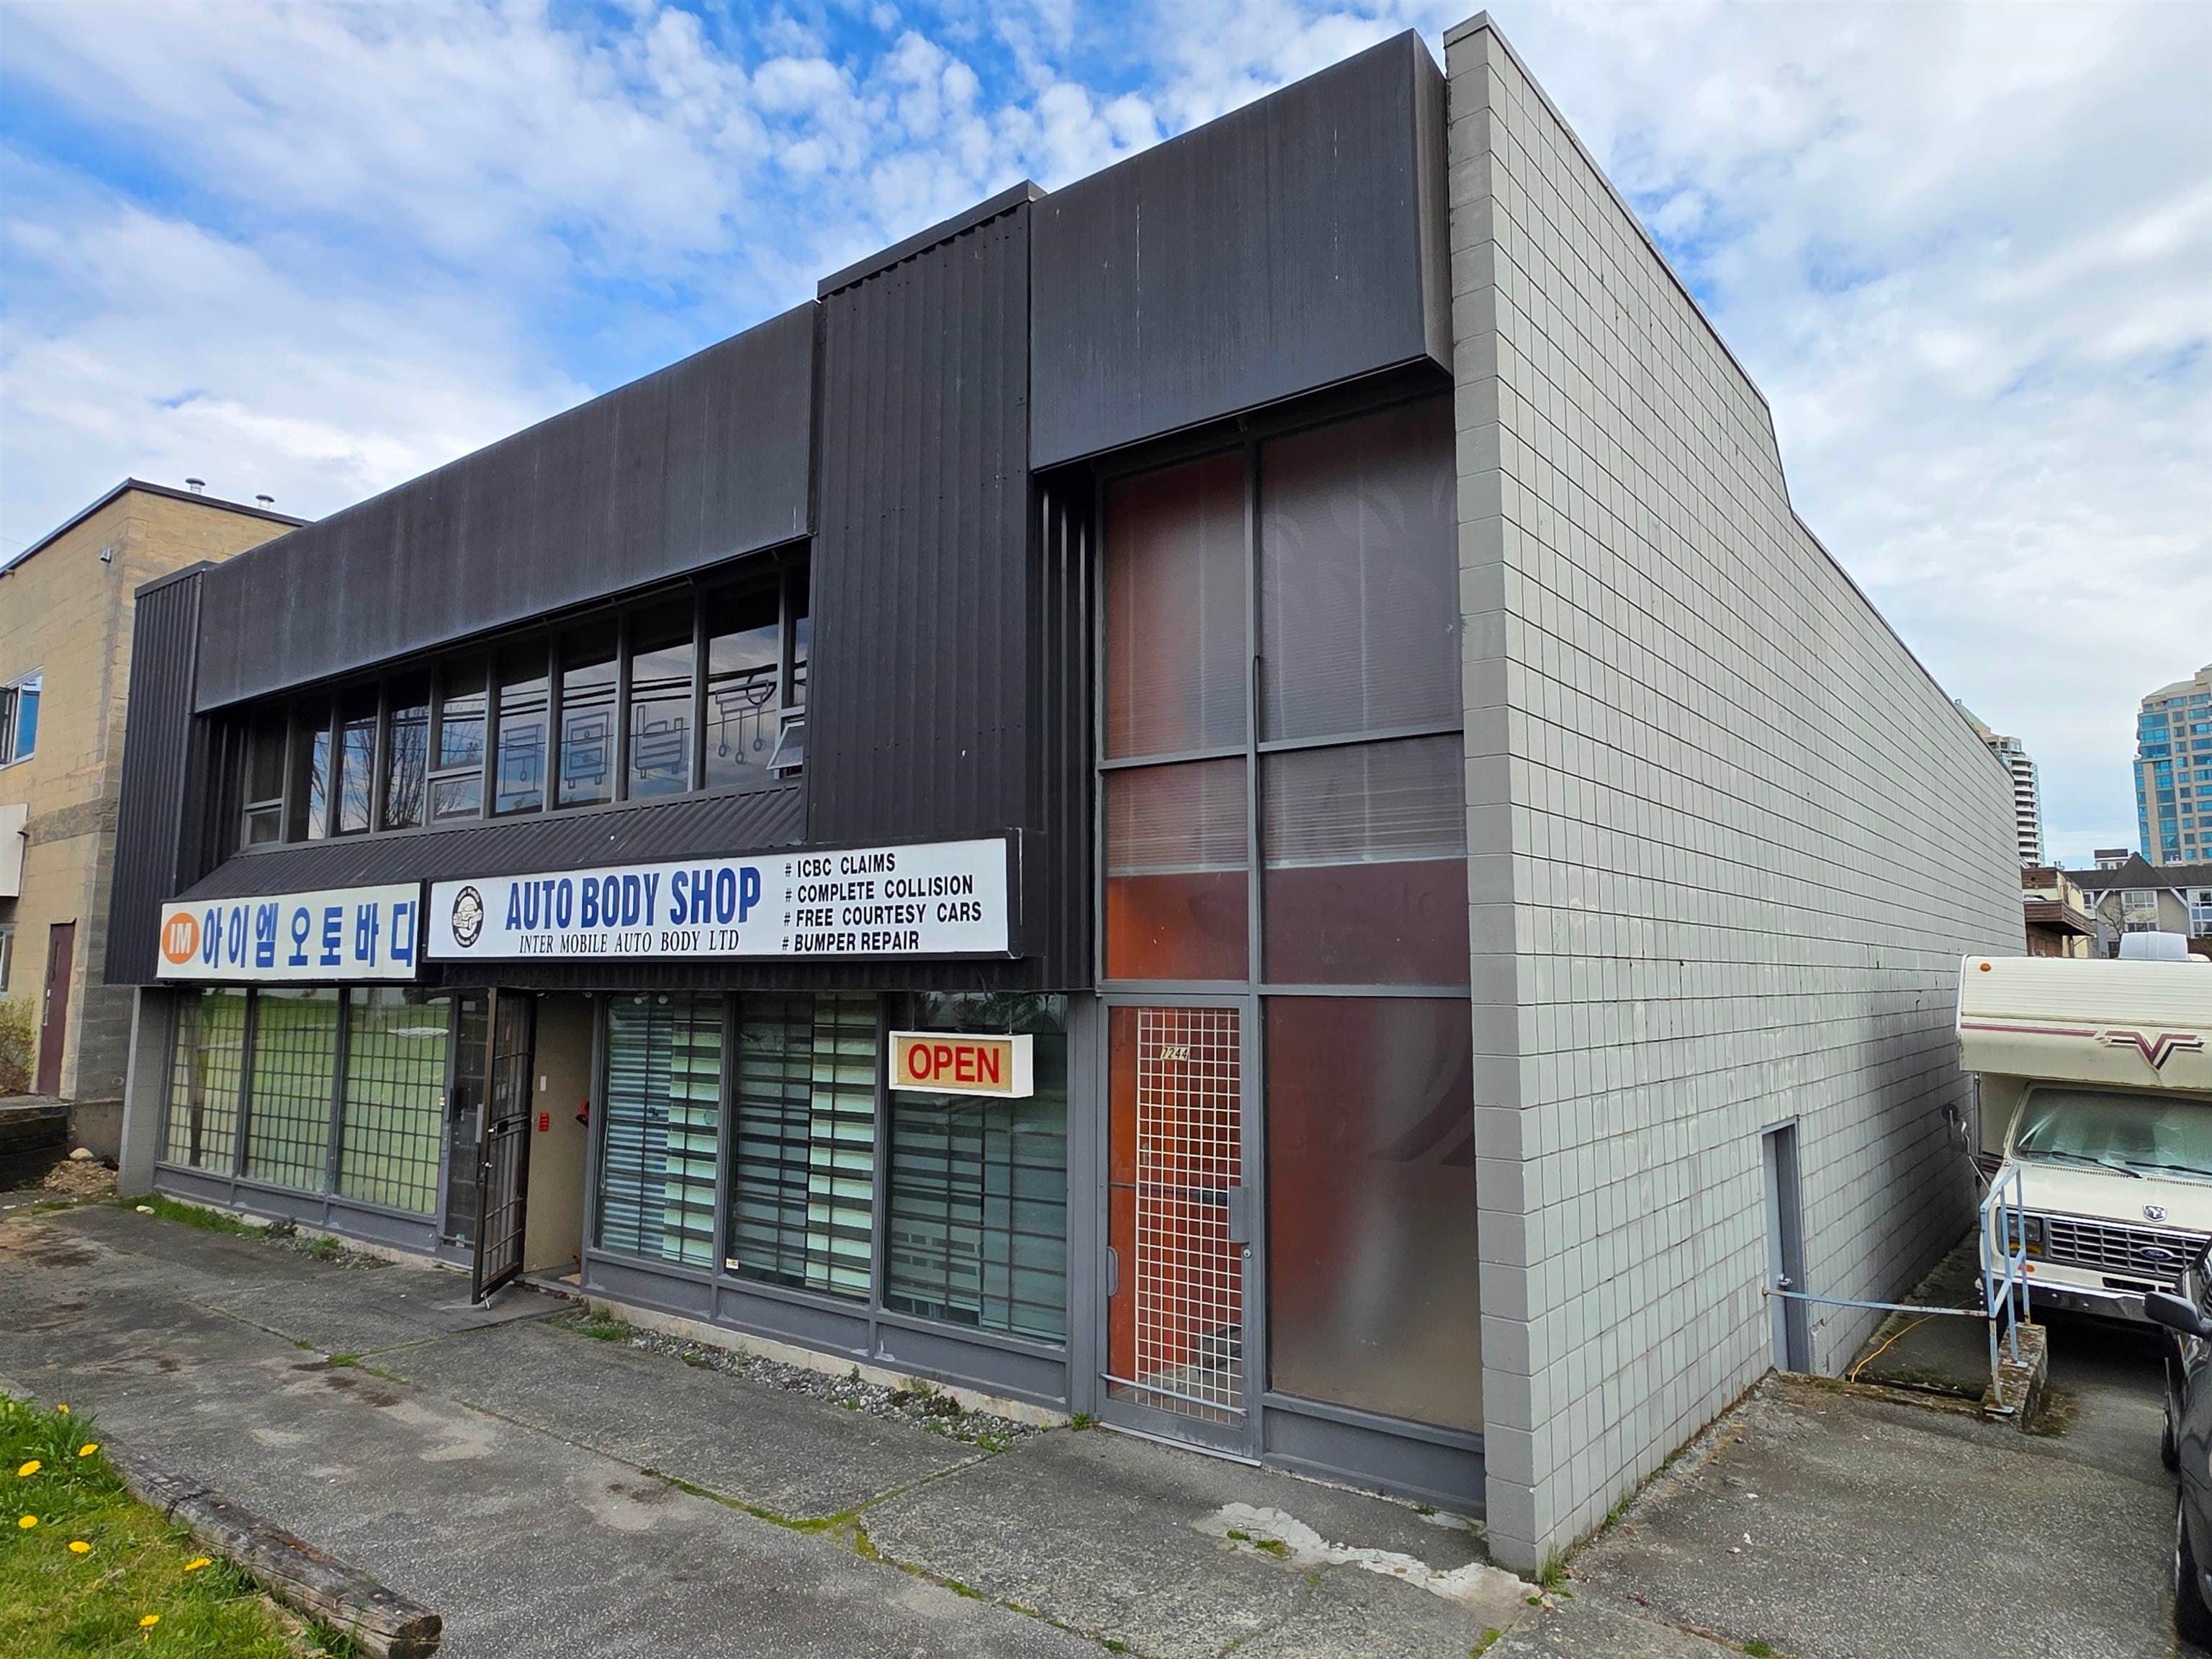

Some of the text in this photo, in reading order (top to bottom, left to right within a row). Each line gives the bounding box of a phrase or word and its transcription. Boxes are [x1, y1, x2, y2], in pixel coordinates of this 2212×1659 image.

[797, 858, 832, 878] ICBC
[840, 853, 896, 875] CLAIMS
[505, 866, 761, 930] AUTO BODY SHOP
[797, 881, 875, 904] COMPLETE
[884, 874, 974, 899] COLLISION
[796, 908, 833, 927] FREE
[842, 904, 927, 926] COURTESY
[937, 901, 982, 923] CARS
[168, 922, 192, 954] IM
[519, 930, 739, 953] INTER MOBILE AUTO BODY LTD
[794, 933, 856, 952] BUMPER
[861, 930, 920, 950] REPAIR
[908, 1043, 999, 1084] OPEN
[1162, 1047, 1188, 1059] 7244
